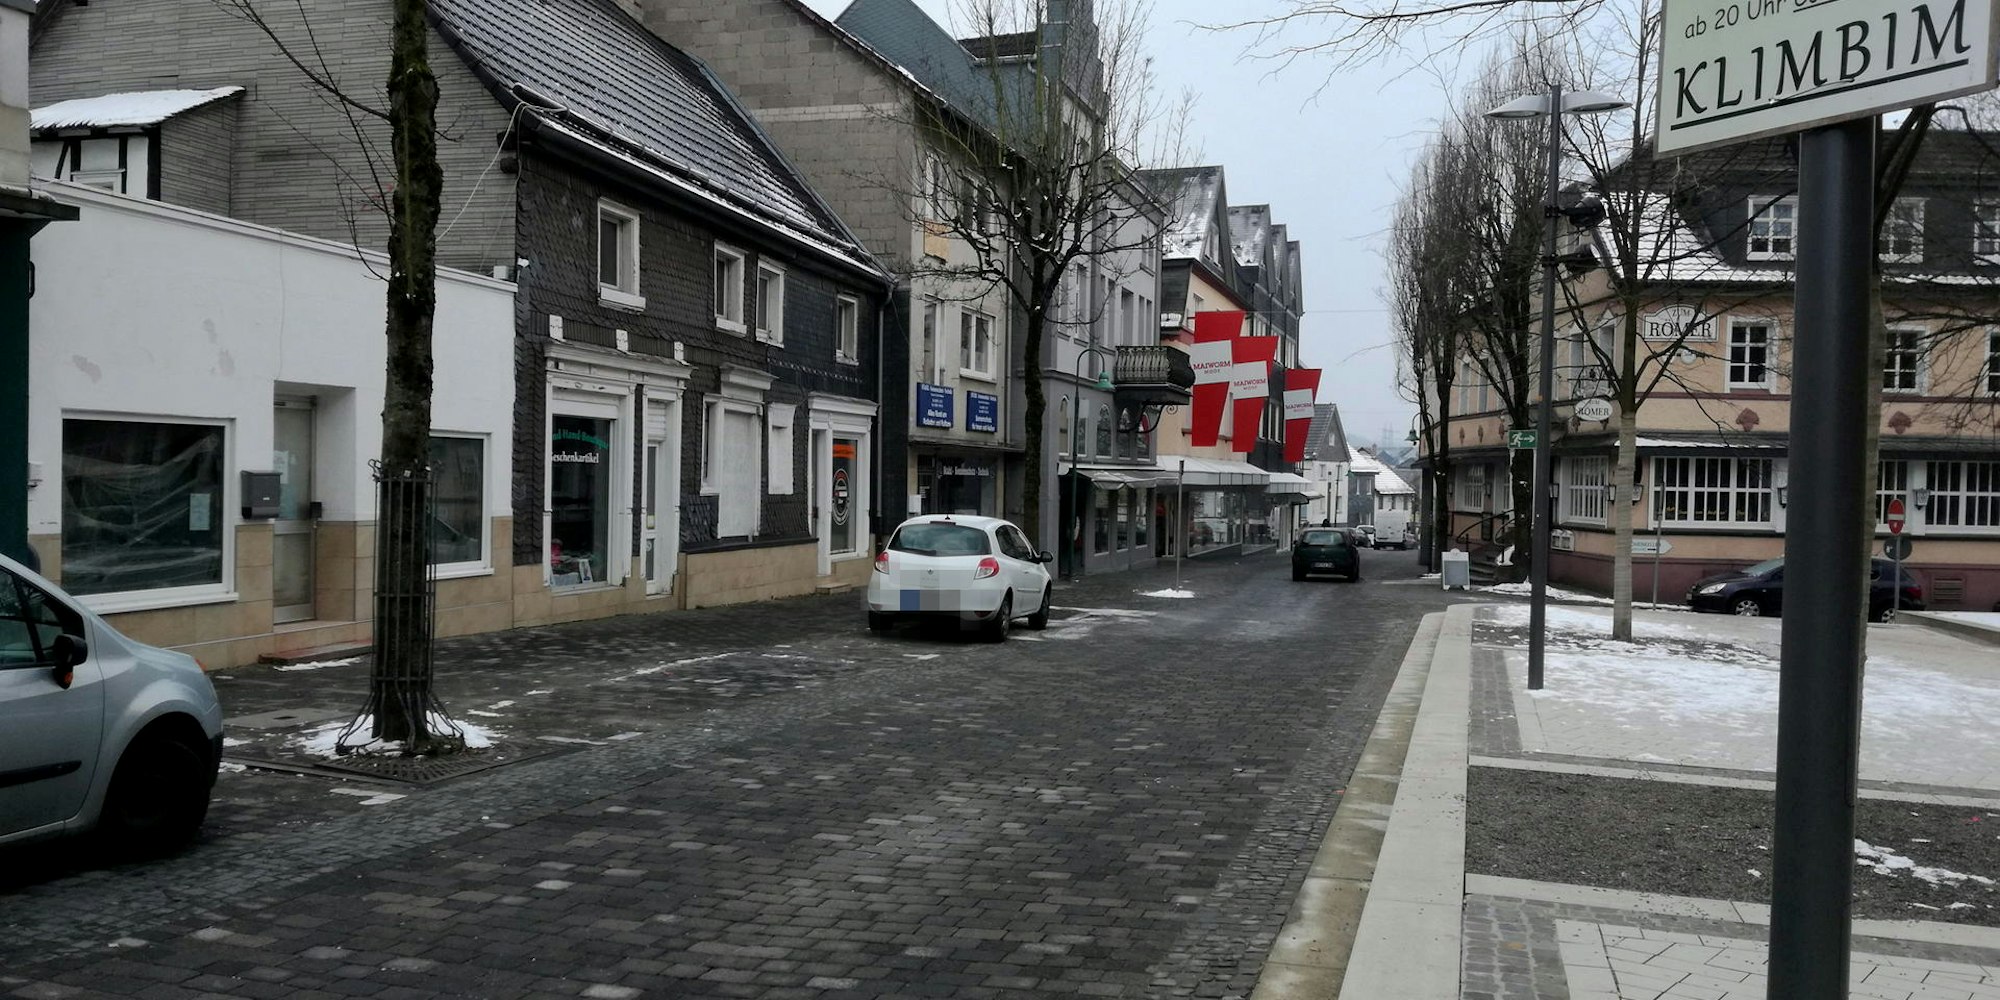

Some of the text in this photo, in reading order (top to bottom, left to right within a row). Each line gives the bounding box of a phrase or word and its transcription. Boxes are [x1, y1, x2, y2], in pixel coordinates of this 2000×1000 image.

[1685, 0, 1786, 39] ab 20 Uhr
[1674, 0, 1971, 118] KLIMBIM
[1193, 360, 1231, 370] MAIWORM
[1233, 378, 1266, 387] MAIWORM
